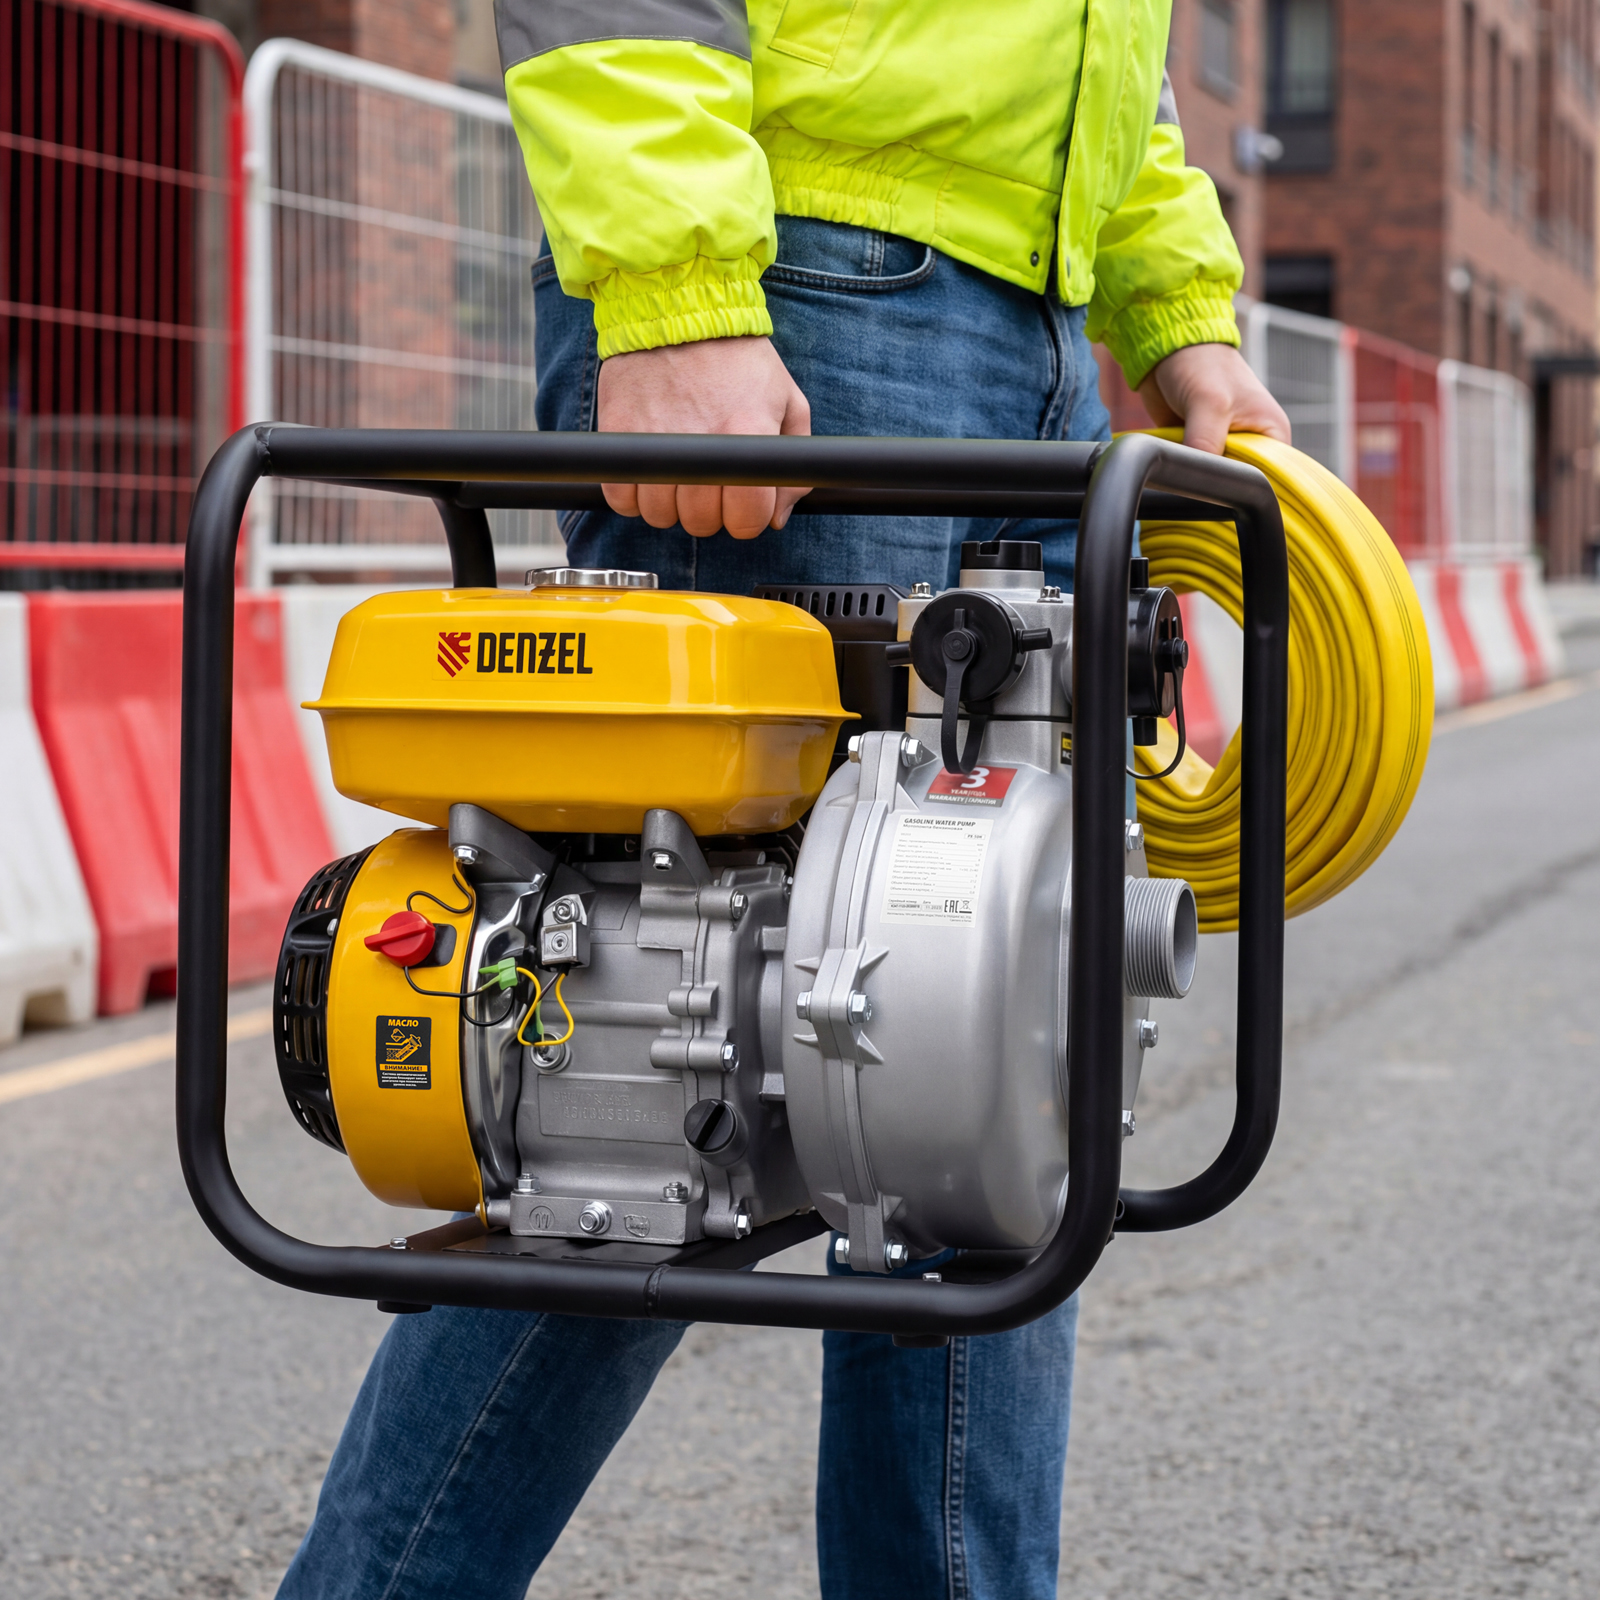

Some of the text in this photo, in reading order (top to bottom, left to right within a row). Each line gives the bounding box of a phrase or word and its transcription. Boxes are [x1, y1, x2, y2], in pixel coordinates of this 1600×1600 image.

[476, 632, 593, 674] DENZEL
[960, 766, 990, 788] 3
[928, 794, 965, 802] WARRANTY
[944, 899, 960, 914] EAC
[387, 1019, 419, 1027] МАСЛО
